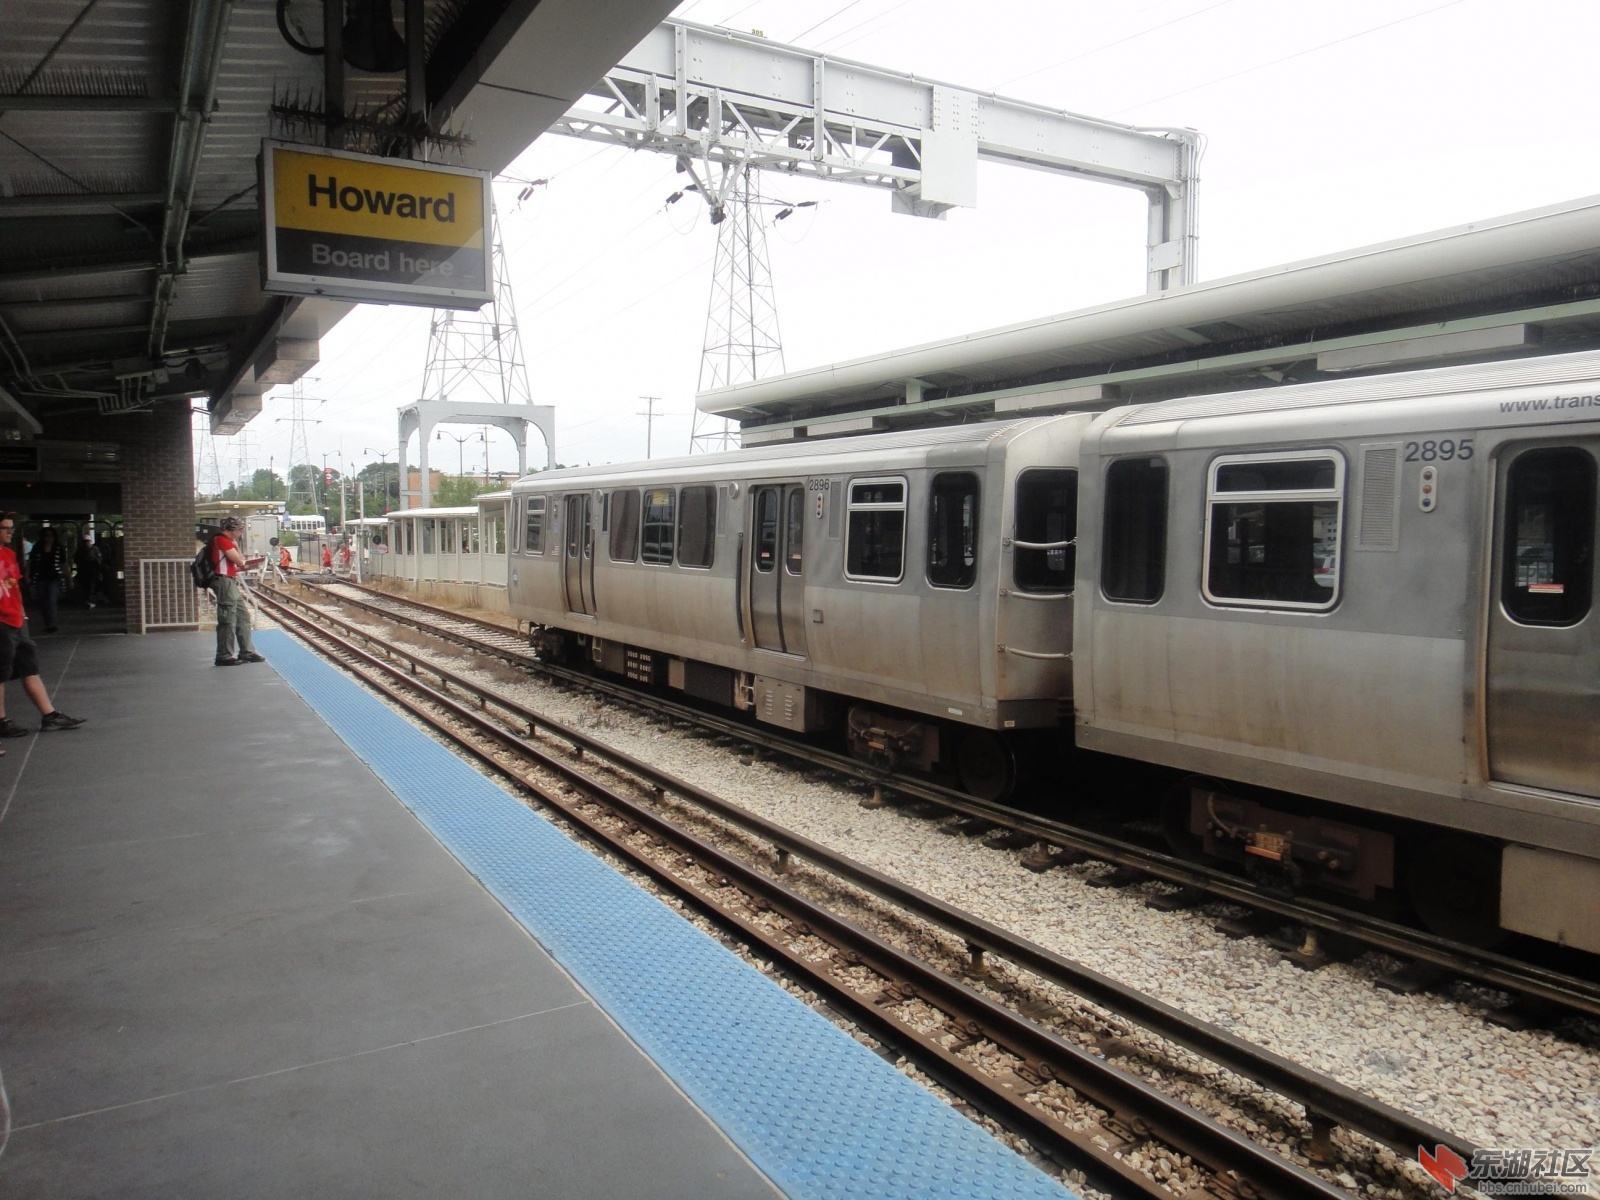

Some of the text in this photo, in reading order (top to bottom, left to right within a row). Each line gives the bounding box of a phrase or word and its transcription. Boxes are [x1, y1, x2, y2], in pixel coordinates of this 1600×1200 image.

[308, 174, 455, 223] Howard
[311, 243, 454, 275] Board here
[1405, 439, 1474, 462] 2895
[809, 478, 830, 491] 2896
